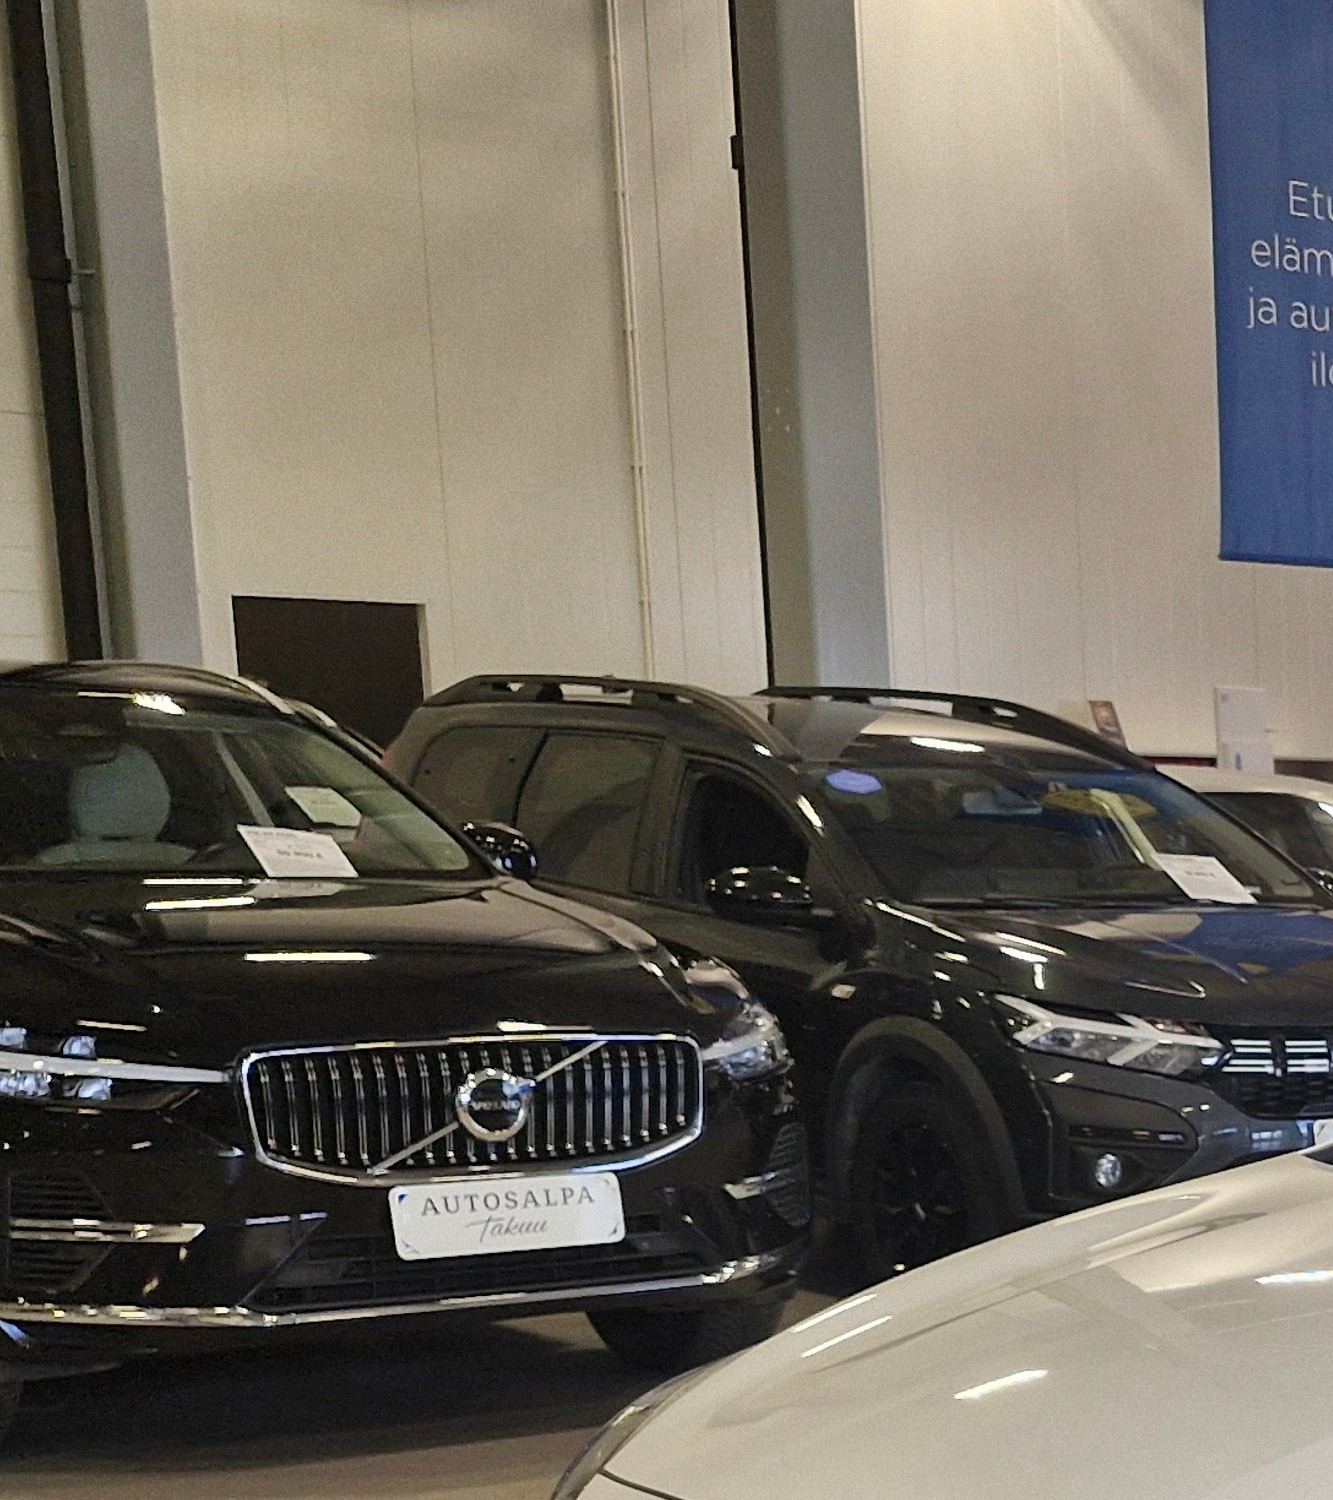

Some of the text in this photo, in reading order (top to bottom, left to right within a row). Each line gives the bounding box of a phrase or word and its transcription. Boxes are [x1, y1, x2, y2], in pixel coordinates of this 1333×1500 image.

[1246, 287, 1278, 329] ja
[421, 1186, 595, 1217] AUTOSALPA
[466, 1215, 548, 1243] Takuu
